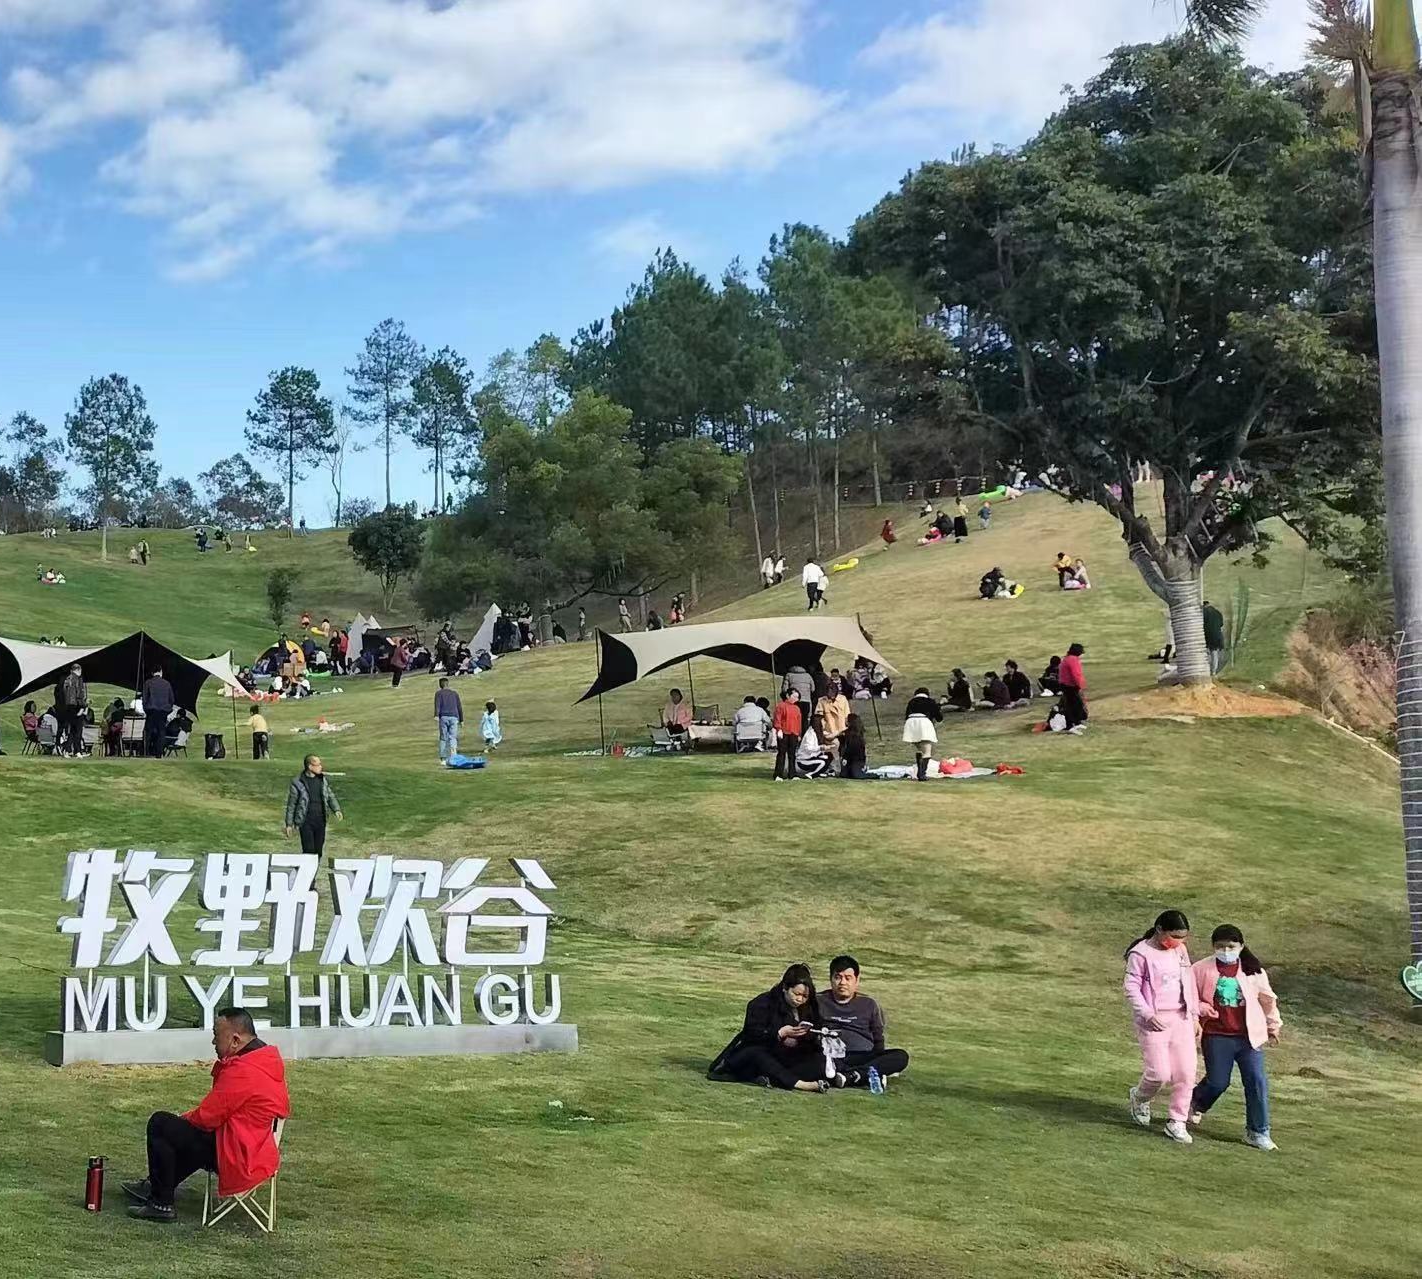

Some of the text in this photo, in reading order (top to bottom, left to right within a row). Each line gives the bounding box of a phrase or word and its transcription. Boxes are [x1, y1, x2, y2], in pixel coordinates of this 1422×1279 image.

[57, 848, 558, 968] 牧野欢谷
[61, 973, 562, 1033] MU YE HUAN GU
